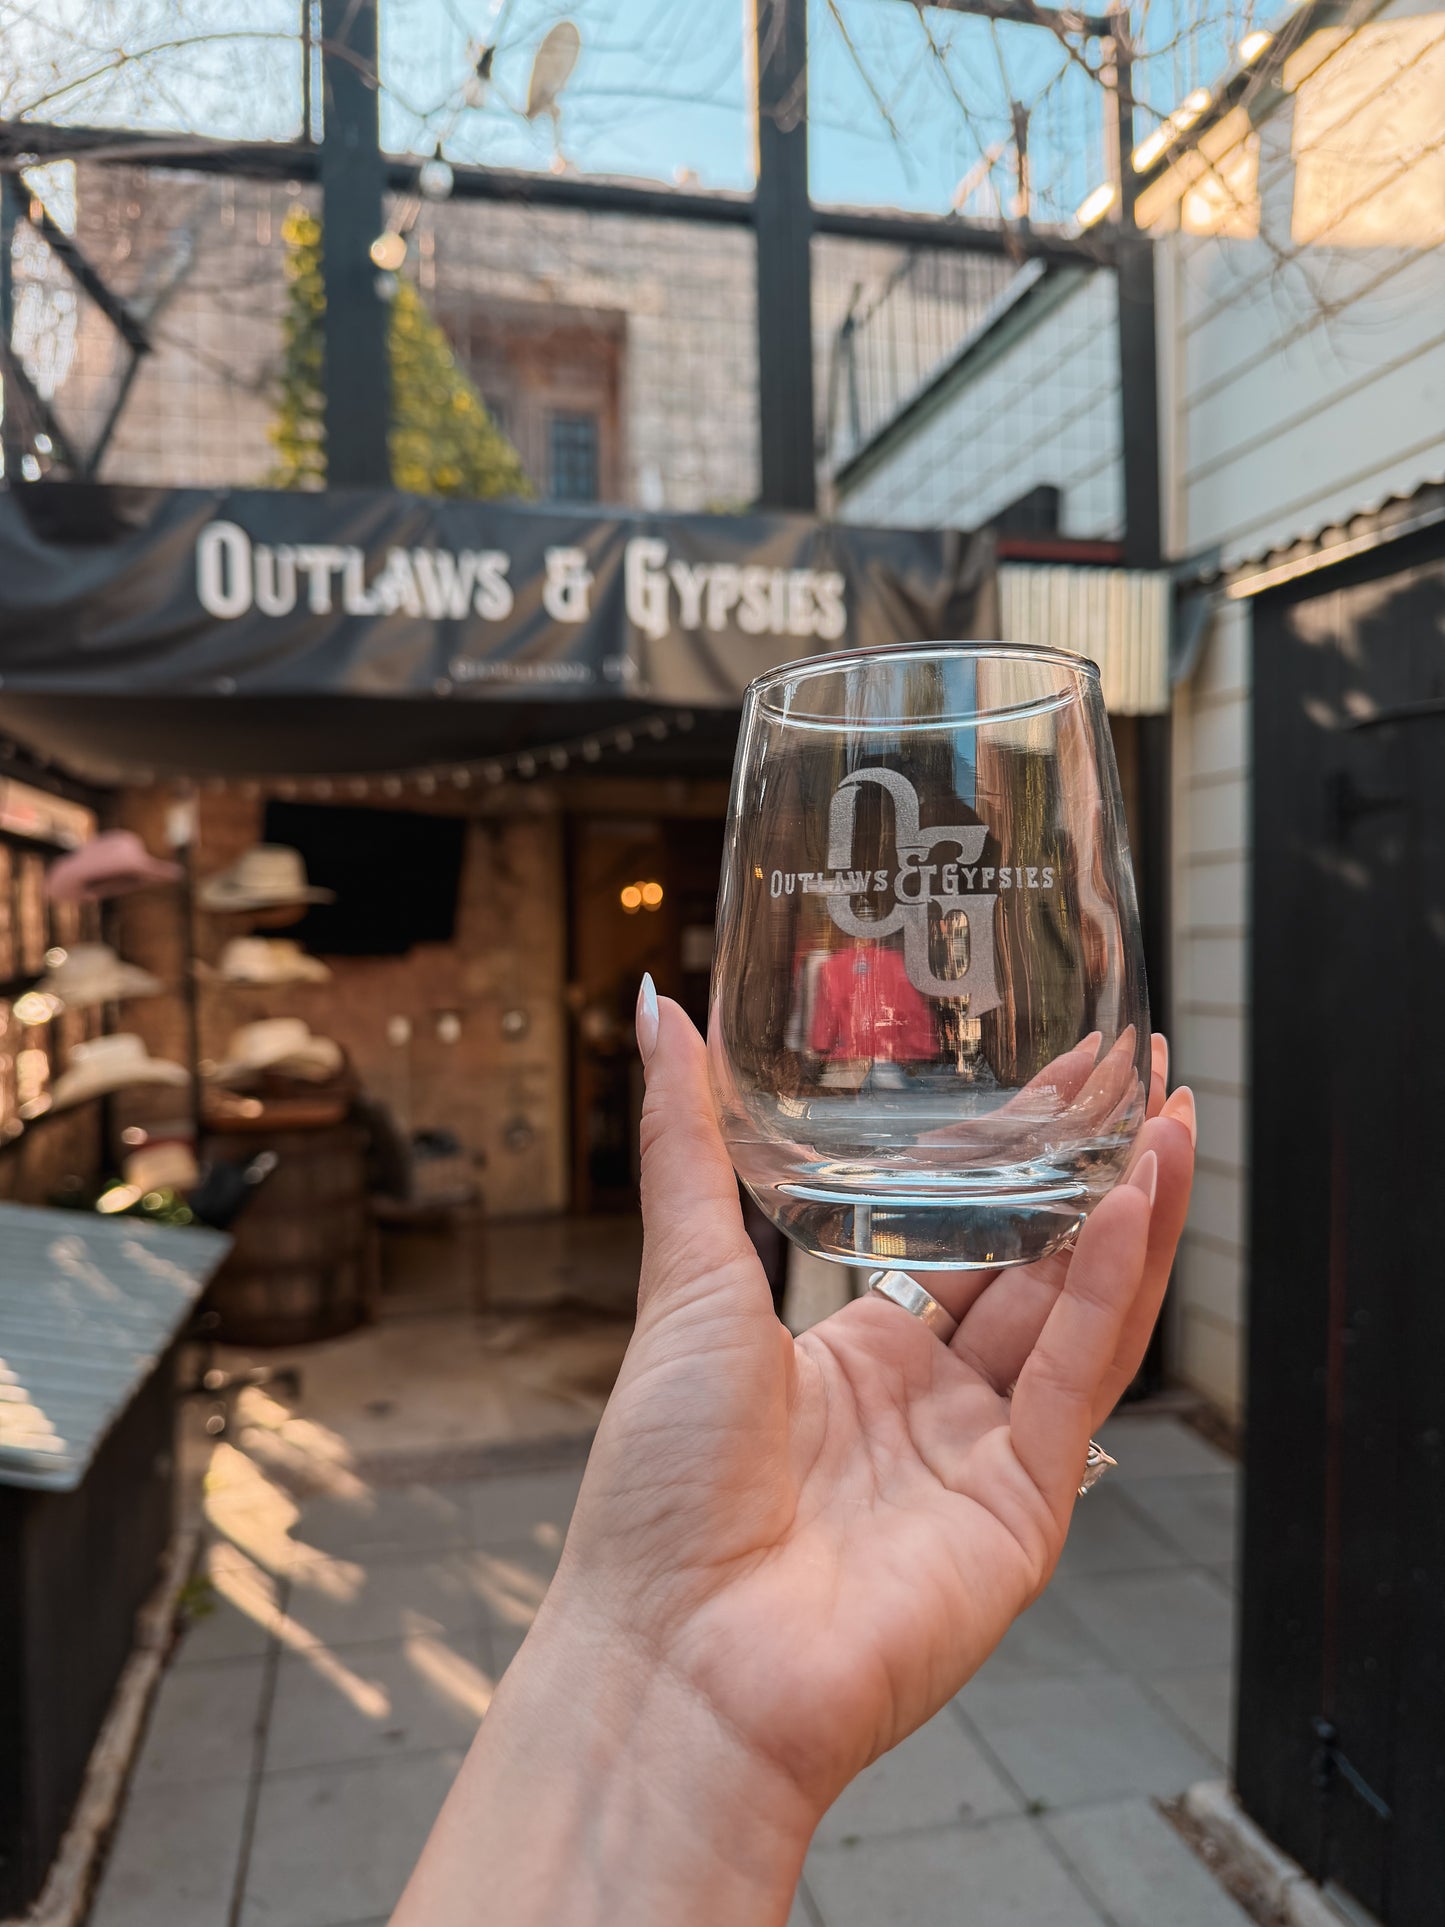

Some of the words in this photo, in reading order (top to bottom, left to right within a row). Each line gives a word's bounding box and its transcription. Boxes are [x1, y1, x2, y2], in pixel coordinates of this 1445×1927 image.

[196, 519, 514, 622] OUTLAWS
[542, 545, 596, 623] &
[624, 536, 848, 640] GYPSIES
[770, 869, 889, 898] OUTLAWS
[894, 847, 937, 904] &
[942, 863, 1055, 895] GYPSIES
